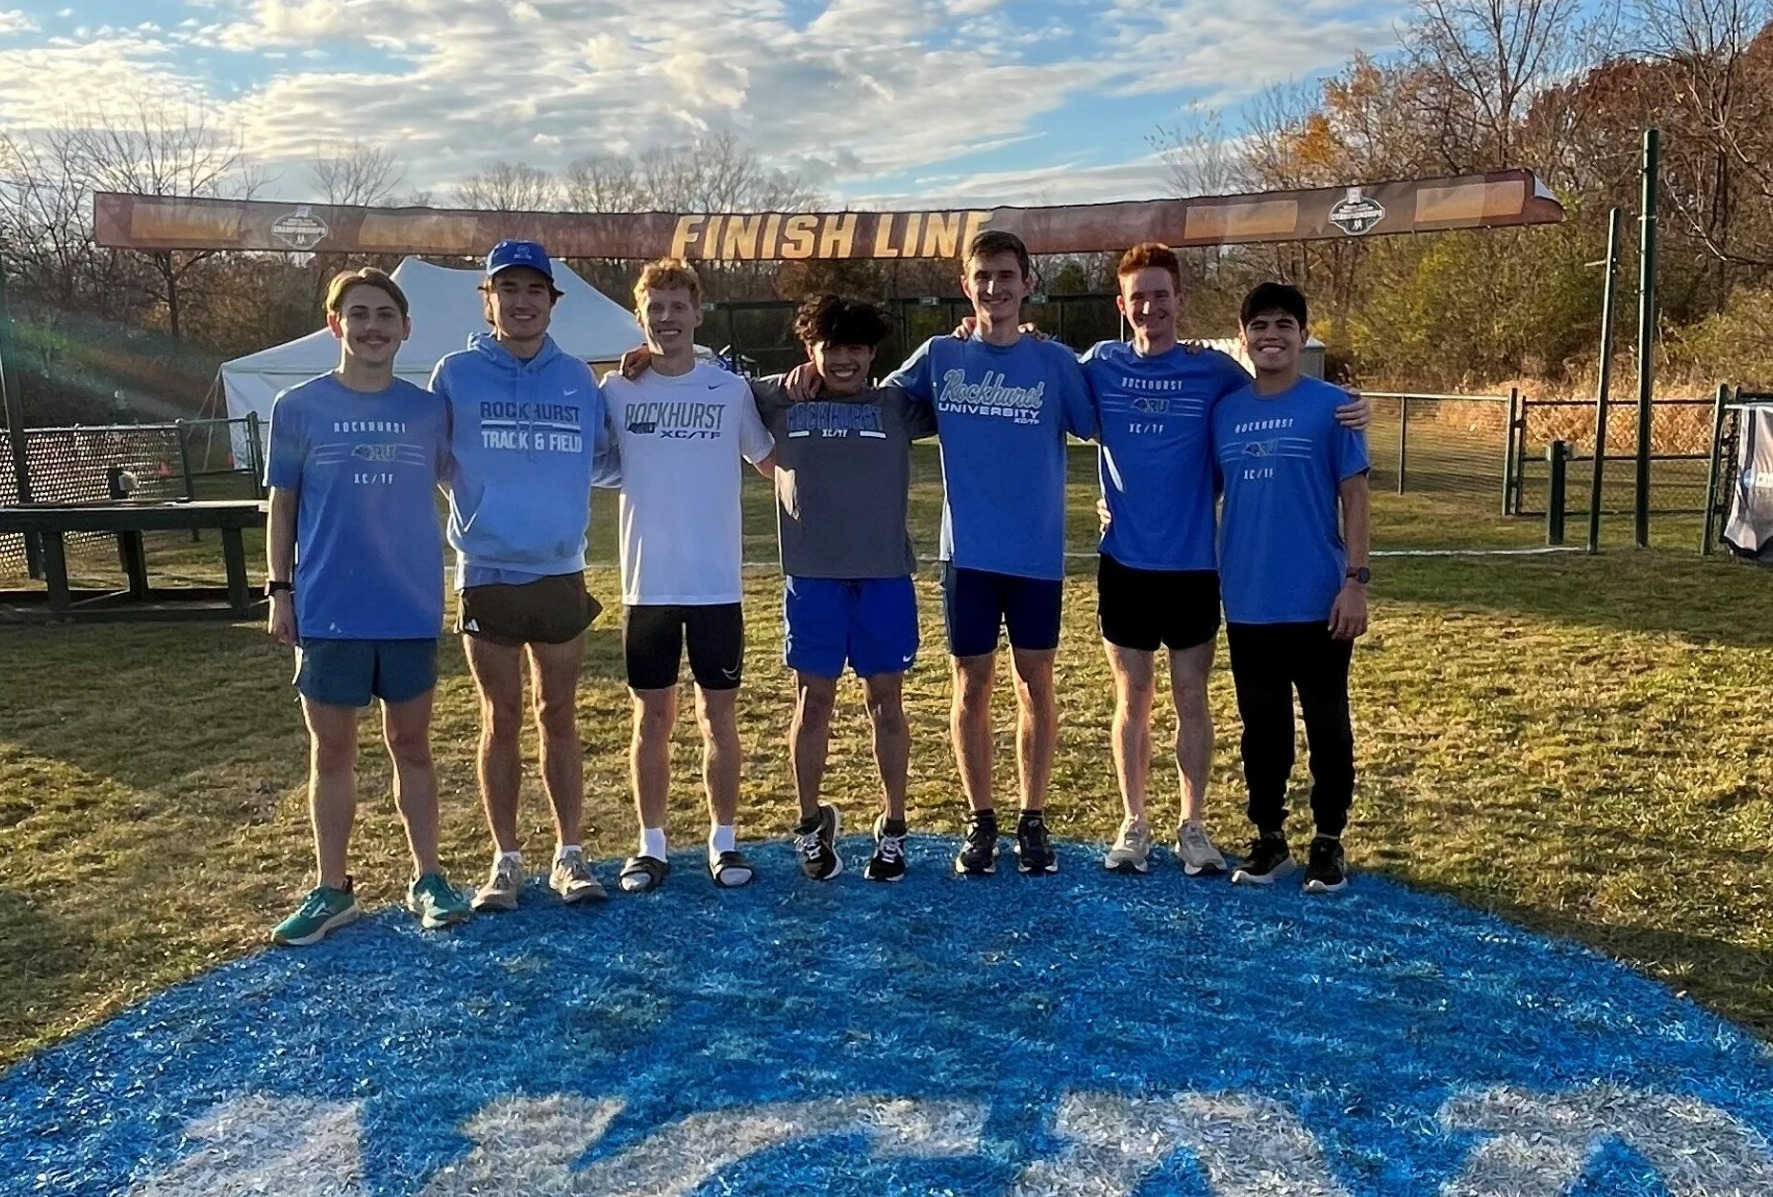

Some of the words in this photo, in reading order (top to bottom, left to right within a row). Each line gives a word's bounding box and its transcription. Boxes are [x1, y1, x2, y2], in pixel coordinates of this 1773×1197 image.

[671, 214, 857, 259] FINISH
[940, 368, 1045, 409] Rockhurst
[1122, 377, 1182, 390] ROCKHURST
[481, 401, 580, 422] ROCKHURST
[625, 402, 726, 430] ROCKHURST
[938, 402, 1040, 419] UNIVERSITY
[333, 421, 406, 434] ROCKHURST
[1129, 423, 1164, 434] XC/TF
[1235, 418, 1293, 433] ROCKHURST
[481, 430, 528, 450] TRACK
[534, 432, 545, 451] &
[549, 433, 582, 453] FIELD
[660, 430, 721, 439] XC/TF
[354, 473, 393, 485] XC/TF
